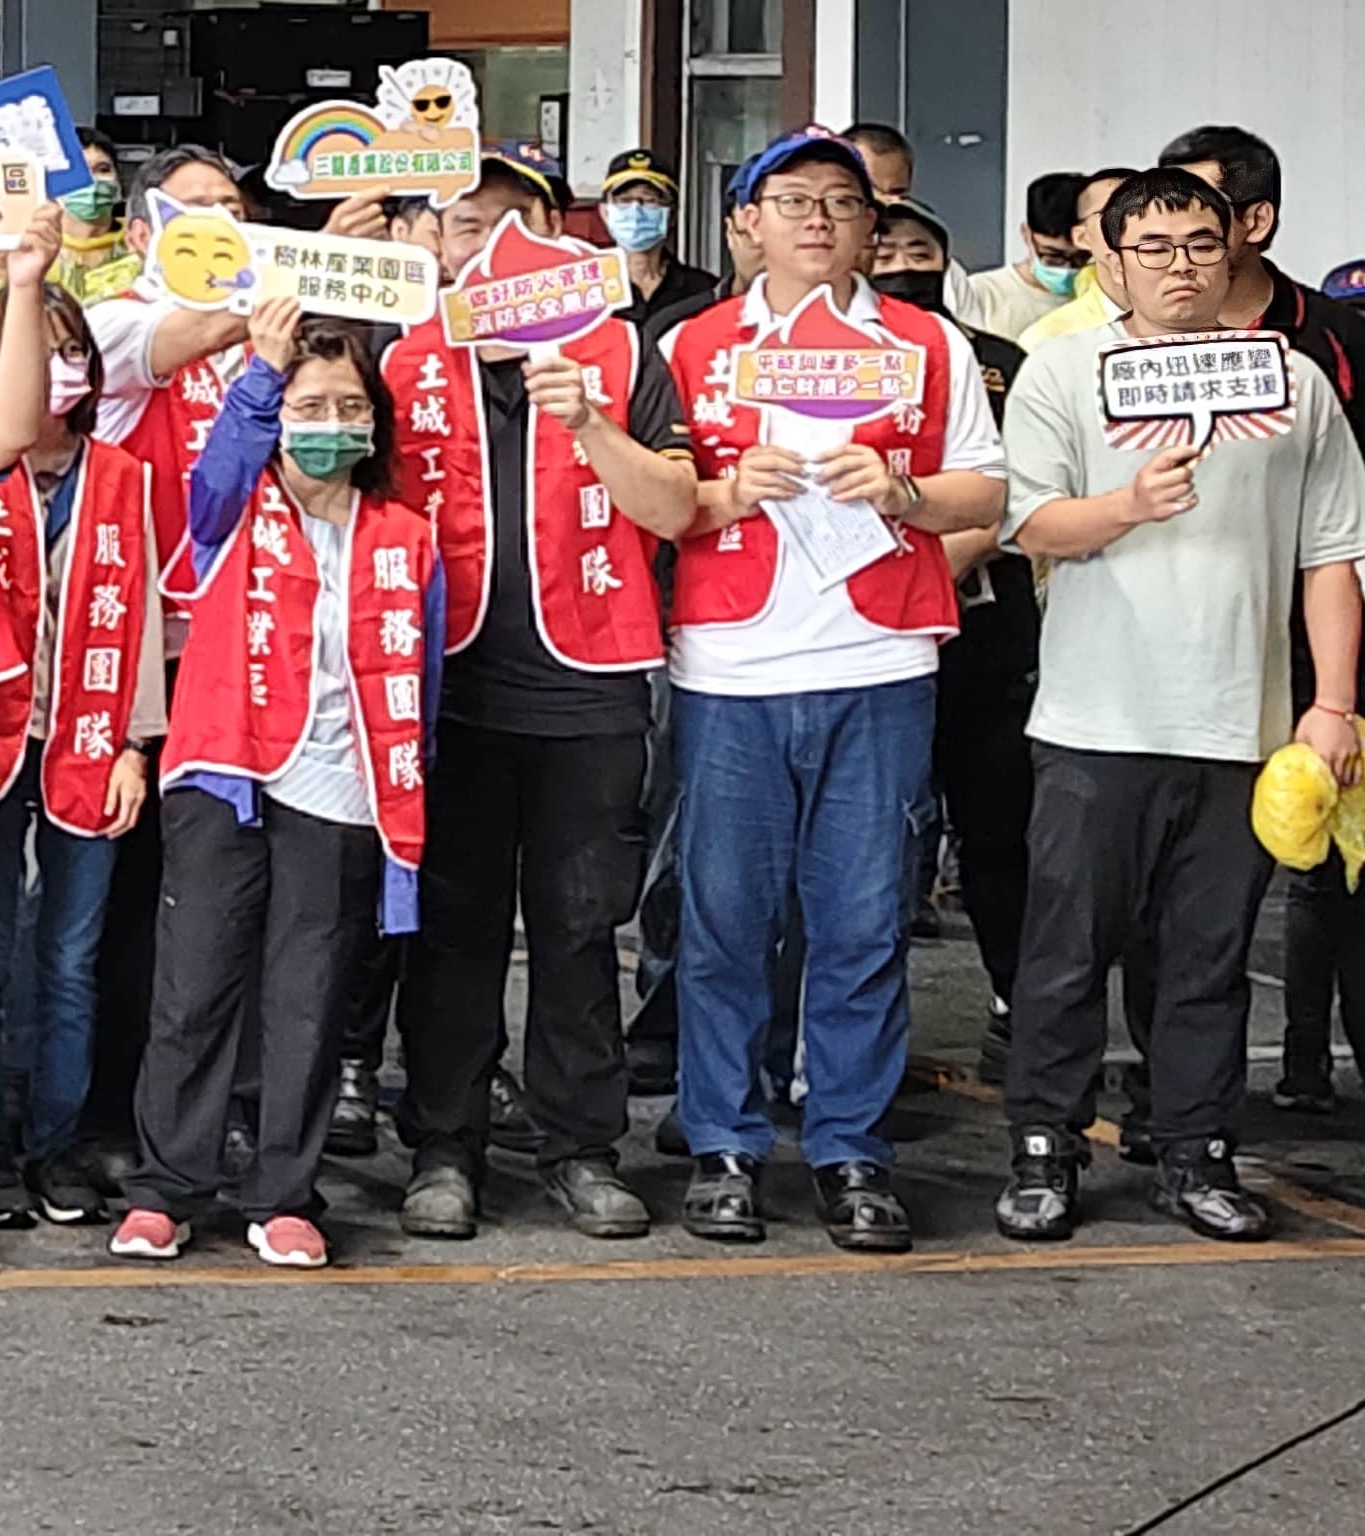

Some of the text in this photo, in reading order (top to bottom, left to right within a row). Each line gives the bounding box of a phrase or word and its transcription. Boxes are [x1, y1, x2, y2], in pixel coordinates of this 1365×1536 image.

[274, 245, 426, 284] 樹林產業園區
[298, 275, 400, 307] 服務中心
[1111, 347, 1272, 381] 廠內迅速應變
[1118, 373, 1278, 407] 即時請求支援
[73, 522, 127, 760] 服務團隊
[372, 546, 425, 790] 服務團隊
